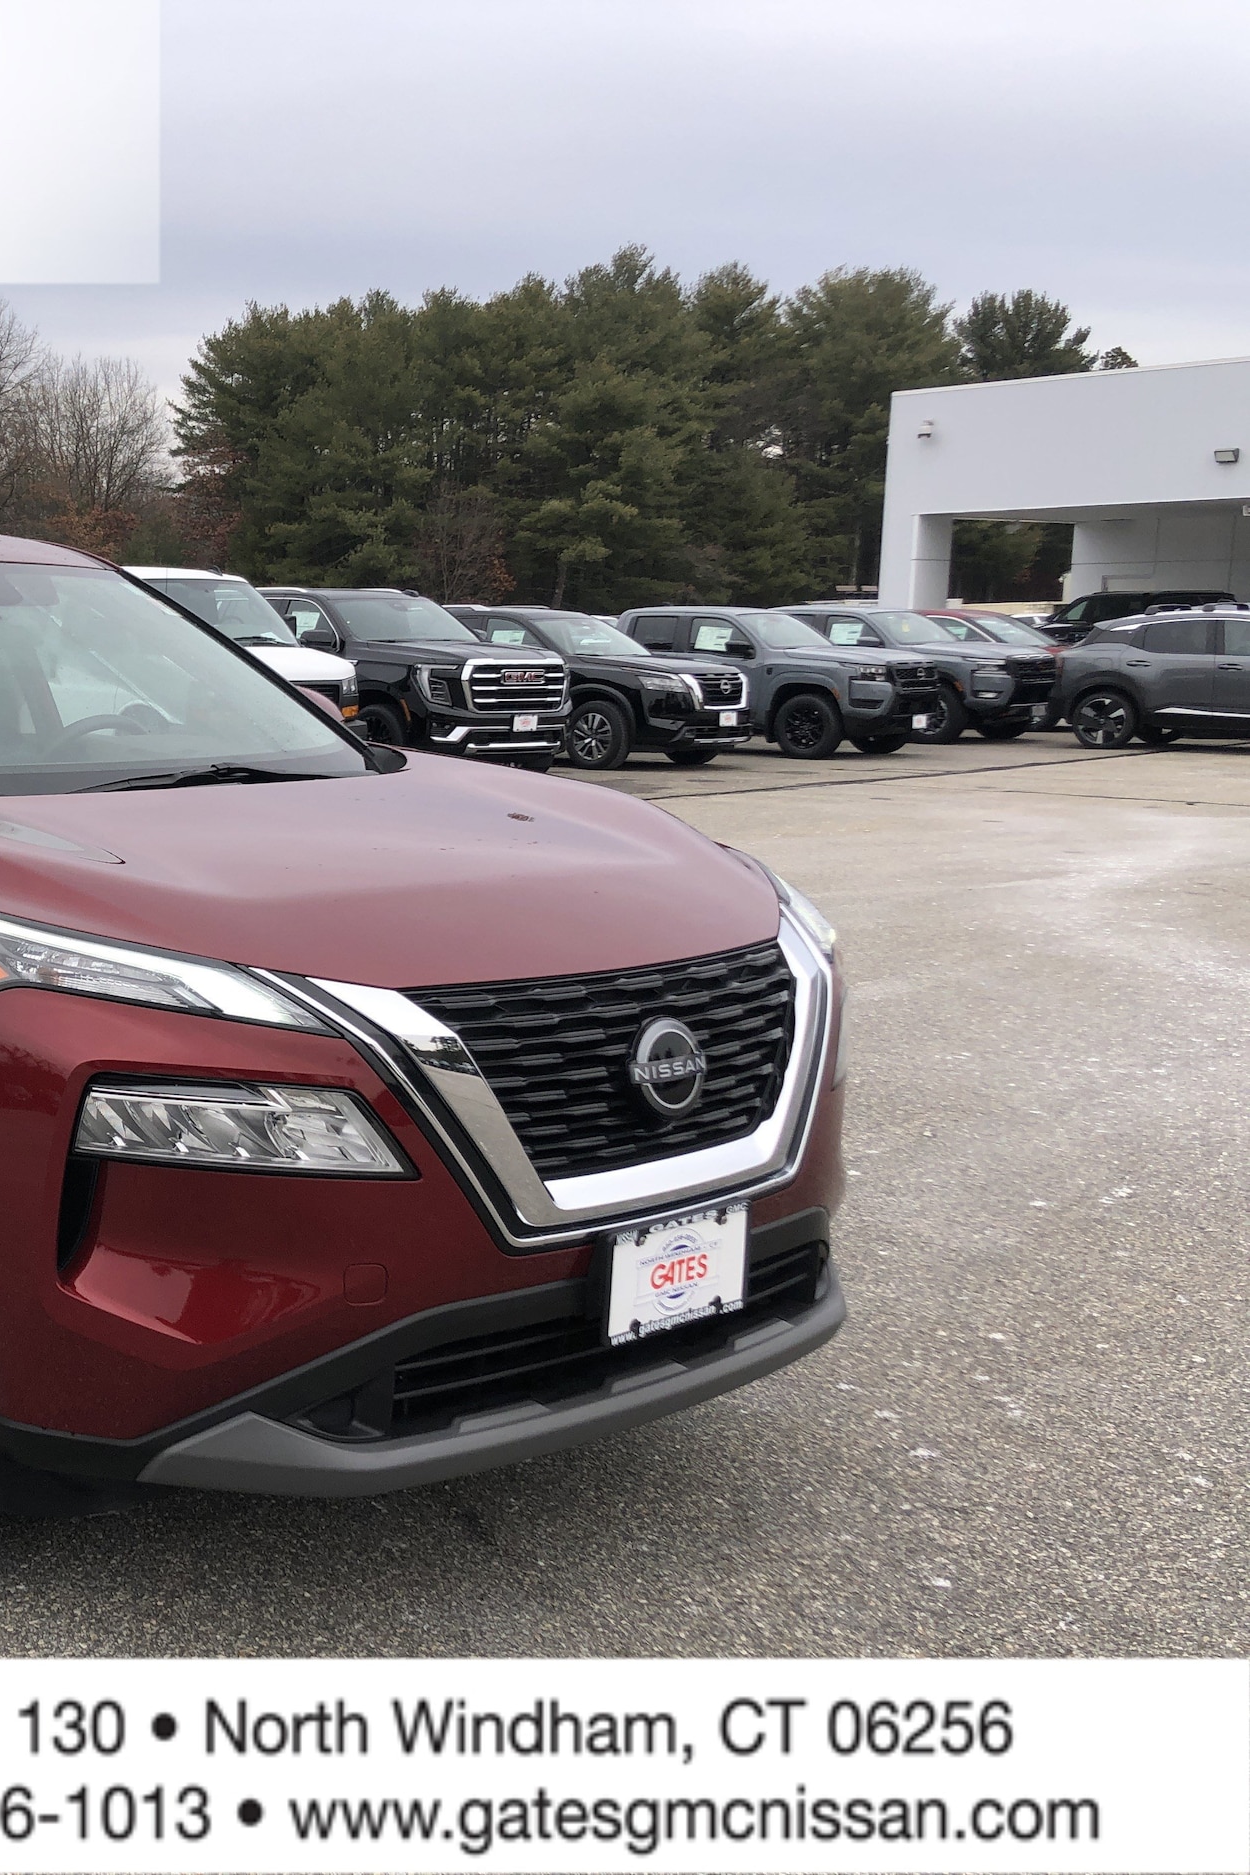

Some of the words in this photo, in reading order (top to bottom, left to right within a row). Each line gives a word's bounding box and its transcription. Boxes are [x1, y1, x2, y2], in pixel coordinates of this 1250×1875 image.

[504, 671, 544, 682] GMC
[633, 1055, 706, 1081] NISSAN
[649, 1209, 718, 1234] GATES
[726, 1202, 749, 1215] GMC
[650, 1254, 708, 1289] GATES
